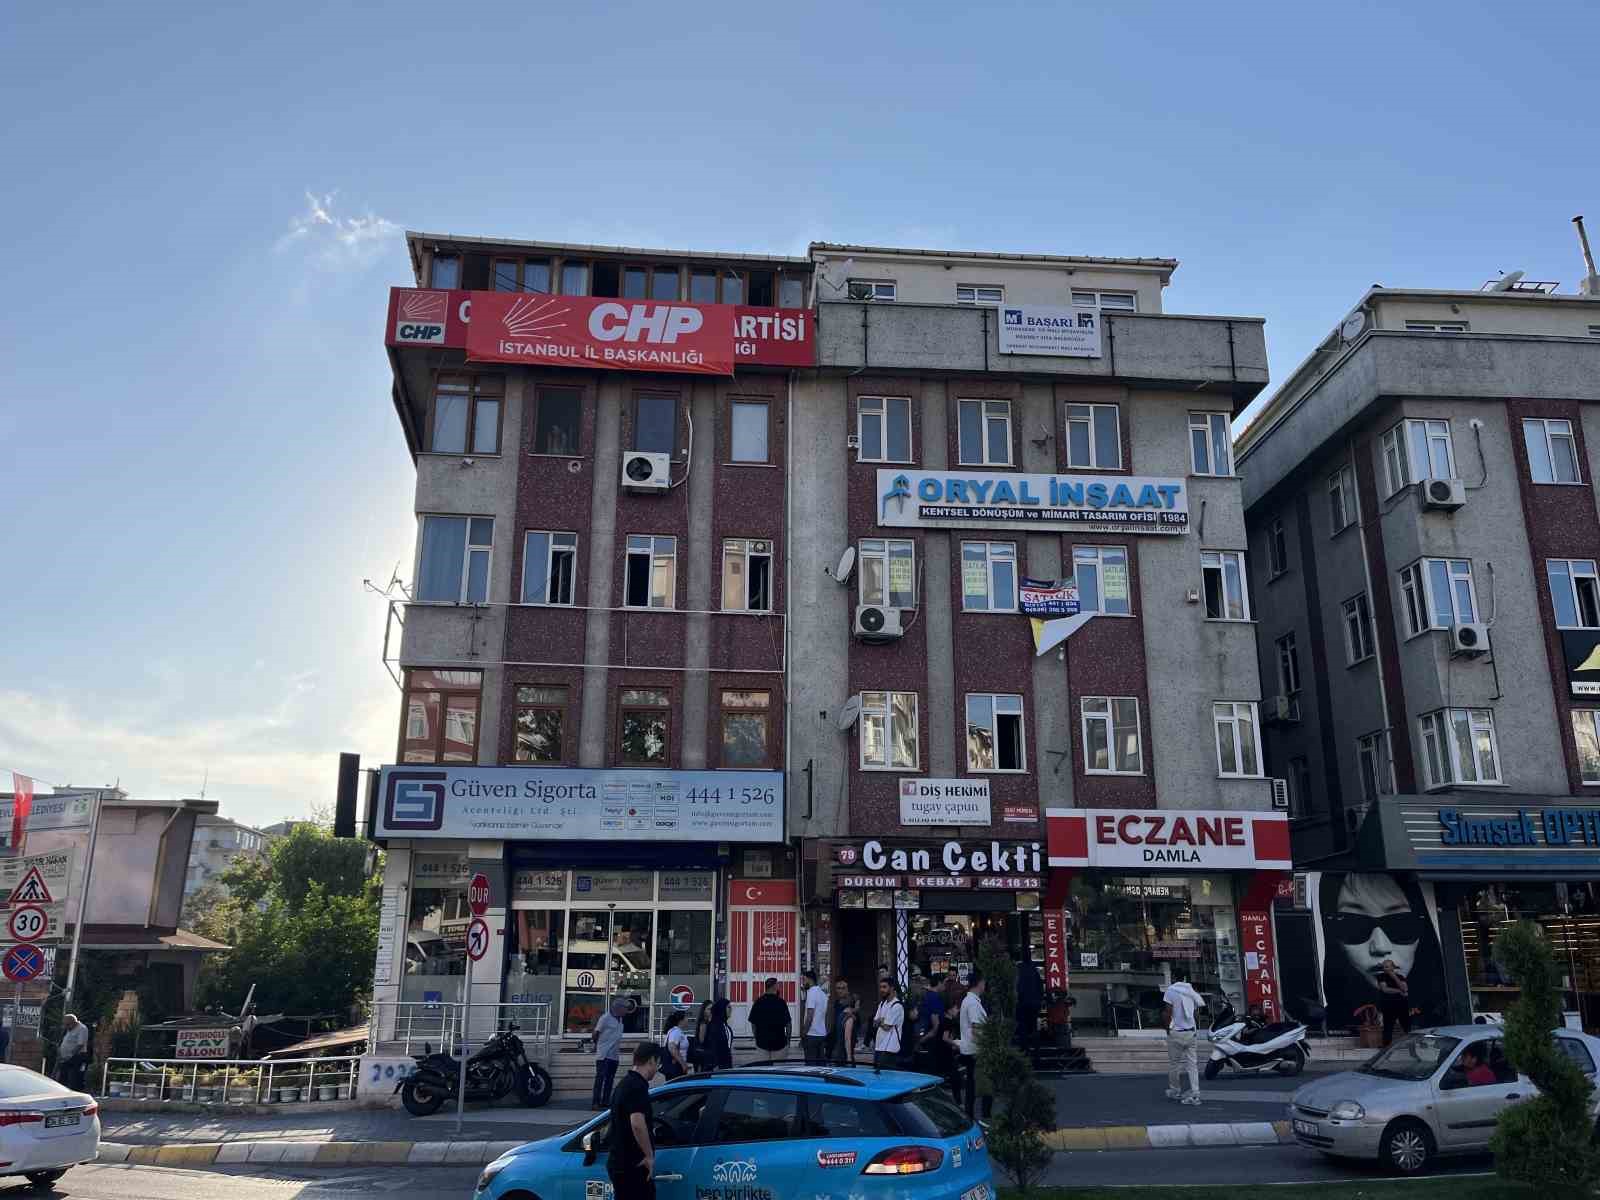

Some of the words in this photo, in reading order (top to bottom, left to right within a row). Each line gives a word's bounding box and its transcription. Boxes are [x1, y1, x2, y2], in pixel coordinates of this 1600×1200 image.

[588, 303, 703, 344] CHP
[400, 325, 442, 340] CHP
[499, 340, 579, 359] İSTANBUL
[585, 343, 600, 360] İL
[604, 346, 703, 364] BAŞKANLIĞI
[918, 477, 1040, 505] ORYAL
[1050, 475, 1181, 511] İNŞAAT
[922, 507, 969, 517] KENTSEL
[972, 508, 1024, 520] DÖNÜŞÜM
[1042, 509, 1080, 520] MİMARİ
[1082, 511, 1127, 521] TASARIM
[1162, 513, 1186, 523] 1984
[451, 779, 517, 798] Güven
[524, 780, 596, 803] Sigorta
[686, 787, 721, 804] 444
[728, 788, 736, 800] 1
[741, 787, 775, 805] 526
[920, 783, 941, 799] DİŞ
[945, 784, 987, 797] HEKİMİ
[912, 802, 942, 815] tugay
[1095, 815, 1247, 846] ECZANE
[840, 850, 855, 860] 79
[863, 840, 930, 871] Can
[943, 841, 1041, 876] Çekti
[1143, 849, 1201, 863] DAMLA
[844, 875, 896, 886] DÜRÜM
[916, 877, 964, 887] KEBAP
[981, 878, 1003, 887] 442
[1024, 879, 1038, 887] 13
[471, 887, 489, 903] DUR
[17, 914, 40, 932] 30
[1255, 925, 1272, 1009] ECZANE
[177, 1048, 225, 1057] SALONU
[724, 1184, 771, 1200] birlikte
